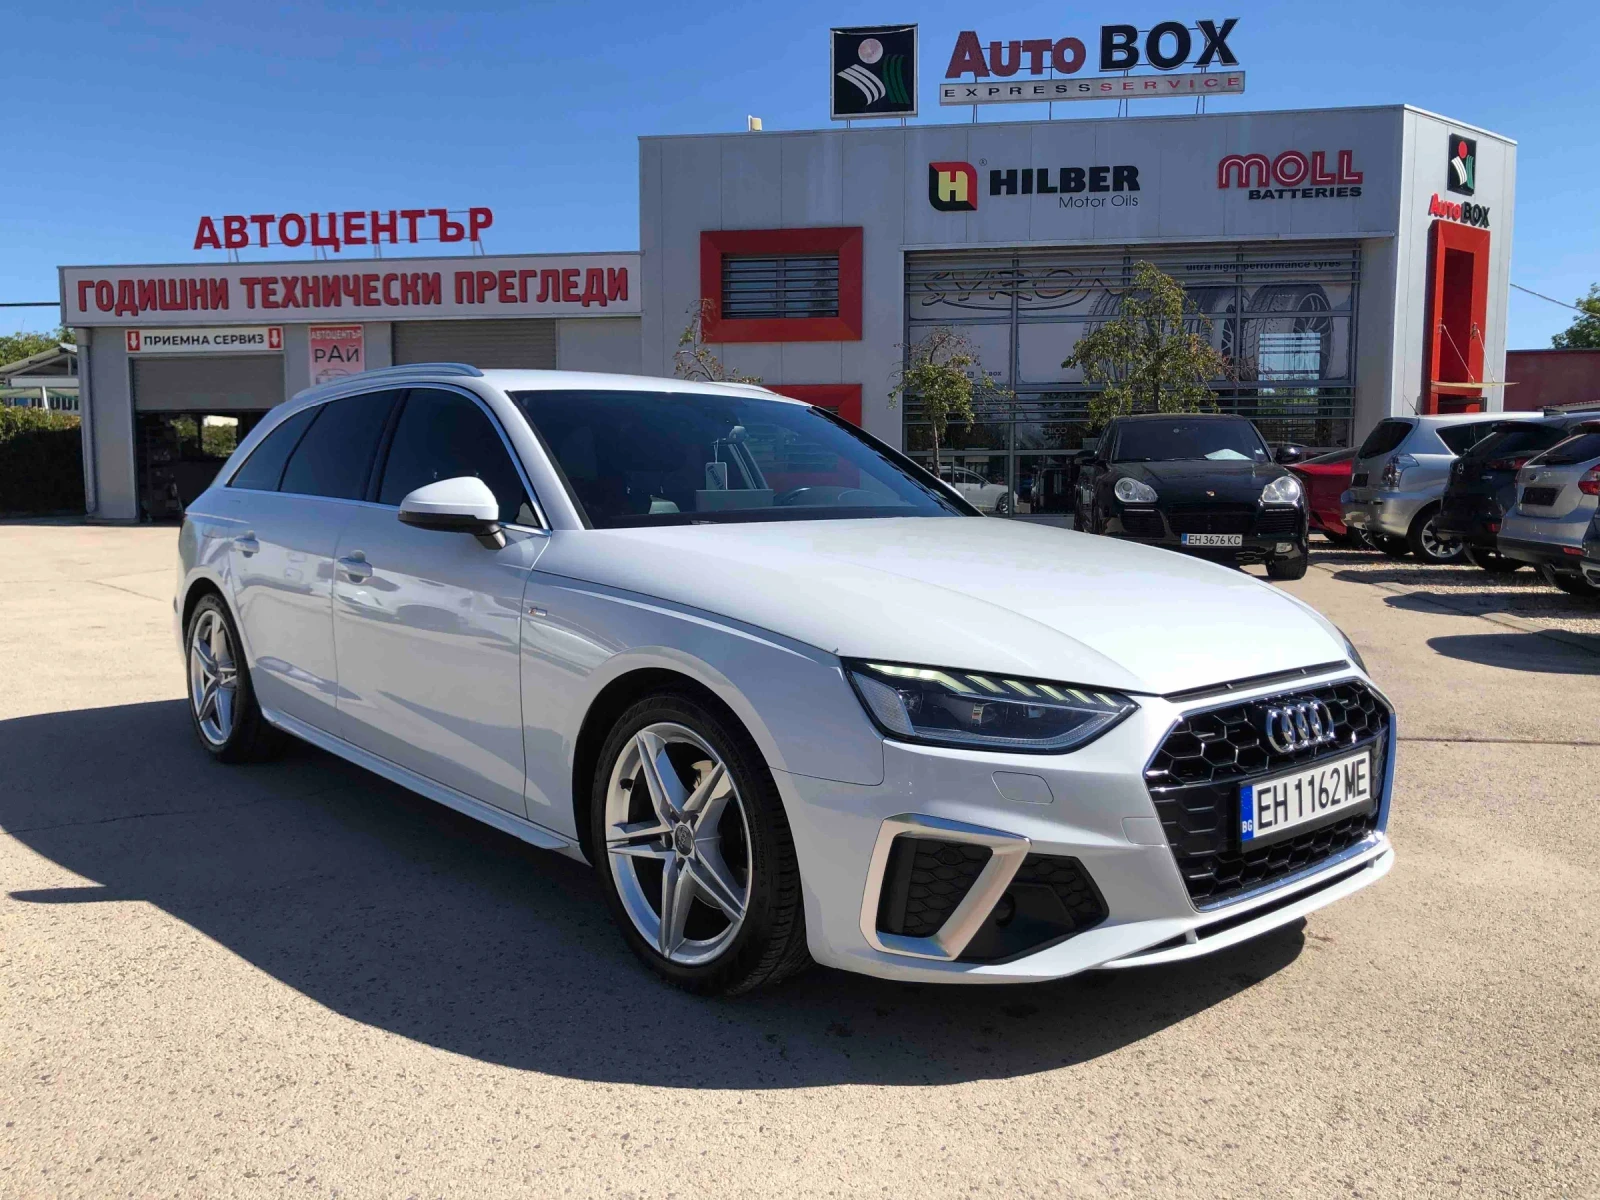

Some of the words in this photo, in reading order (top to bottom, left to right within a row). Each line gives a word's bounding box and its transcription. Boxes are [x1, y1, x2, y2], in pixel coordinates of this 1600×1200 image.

[1098, 17, 1240, 72] BOX
[989, 165, 1141, 196] HILBER
[1059, 196, 1107, 209] Motor
[1111, 194, 1139, 207] Oils
[1248, 186, 1362, 201] BATTERIES
[193, 207, 493, 252] АВТОЦЕНТЪР
[77, 277, 230, 317] ГОДИШНИ
[240, 271, 442, 309] ТЕХНИЧЕСКИ
[454, 266, 629, 308] ПРЕГЛЕДИ
[143, 334, 211, 346] ПРИЕМНА
[213, 332, 265, 345] СЕРВИЗ
[310, 330, 362, 340] АВТОЦЕНТЪР
[314, 344, 360, 364] РАЙ
[1241, 819, 1253, 834] BG
